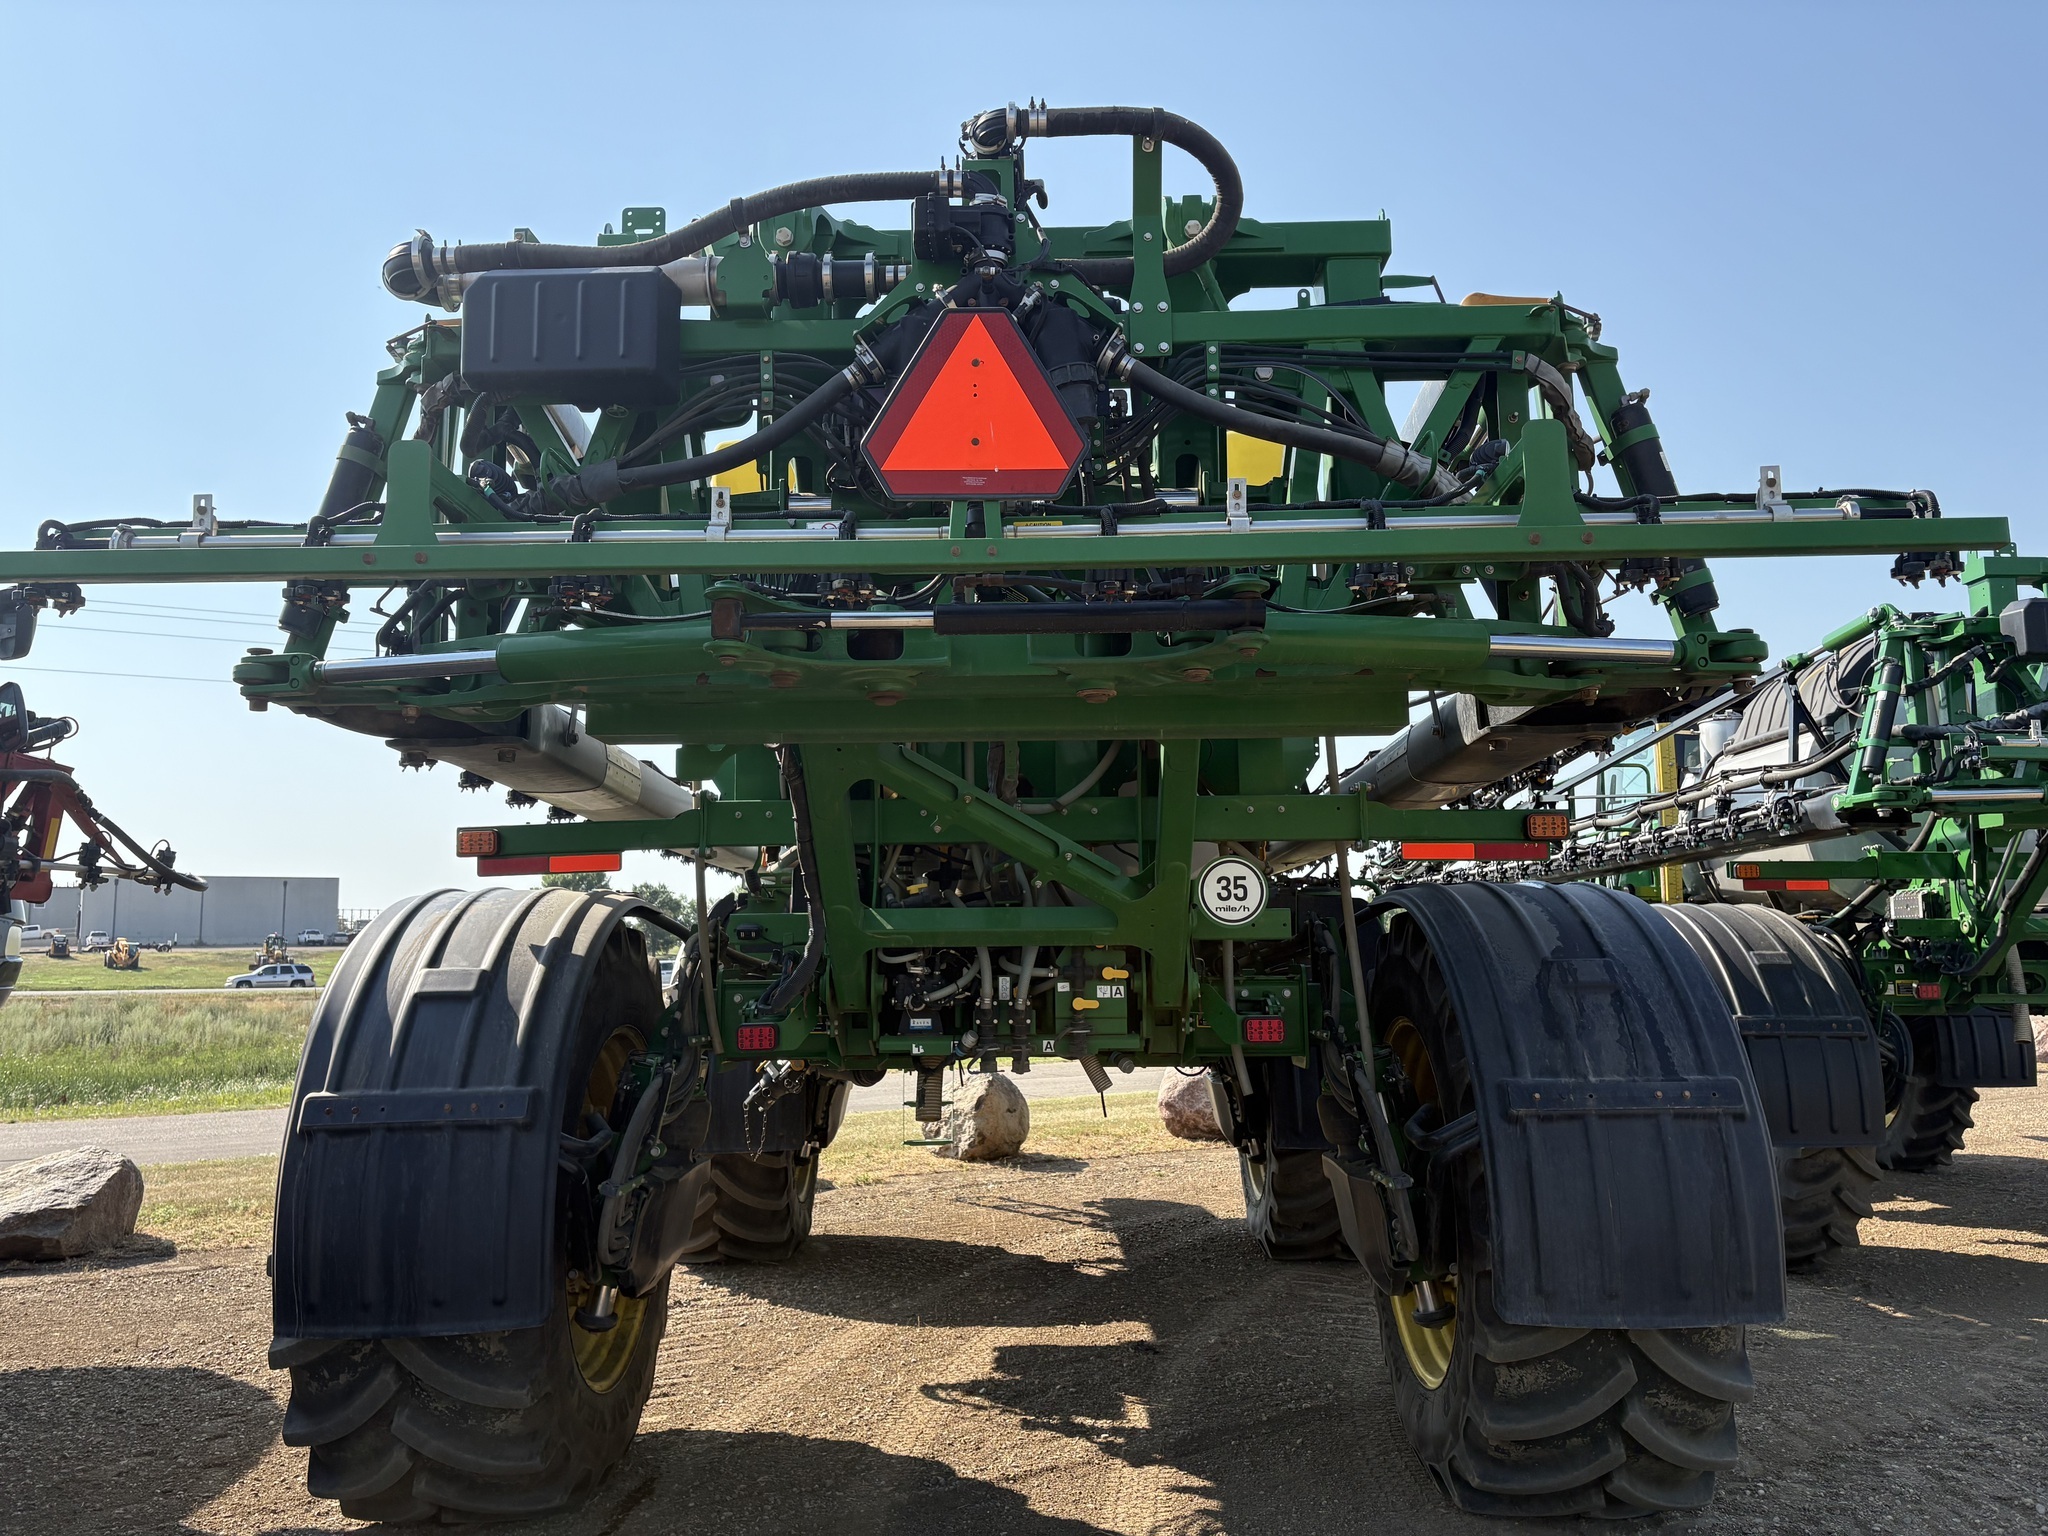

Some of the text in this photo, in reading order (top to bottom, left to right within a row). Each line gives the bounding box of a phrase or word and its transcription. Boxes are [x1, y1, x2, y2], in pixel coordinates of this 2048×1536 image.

[1216, 875, 1248, 902] 35
[1215, 905, 1250, 913] mile/h
[1113, 987, 1123, 997] A
[1044, 1041, 1053, 1051] A
